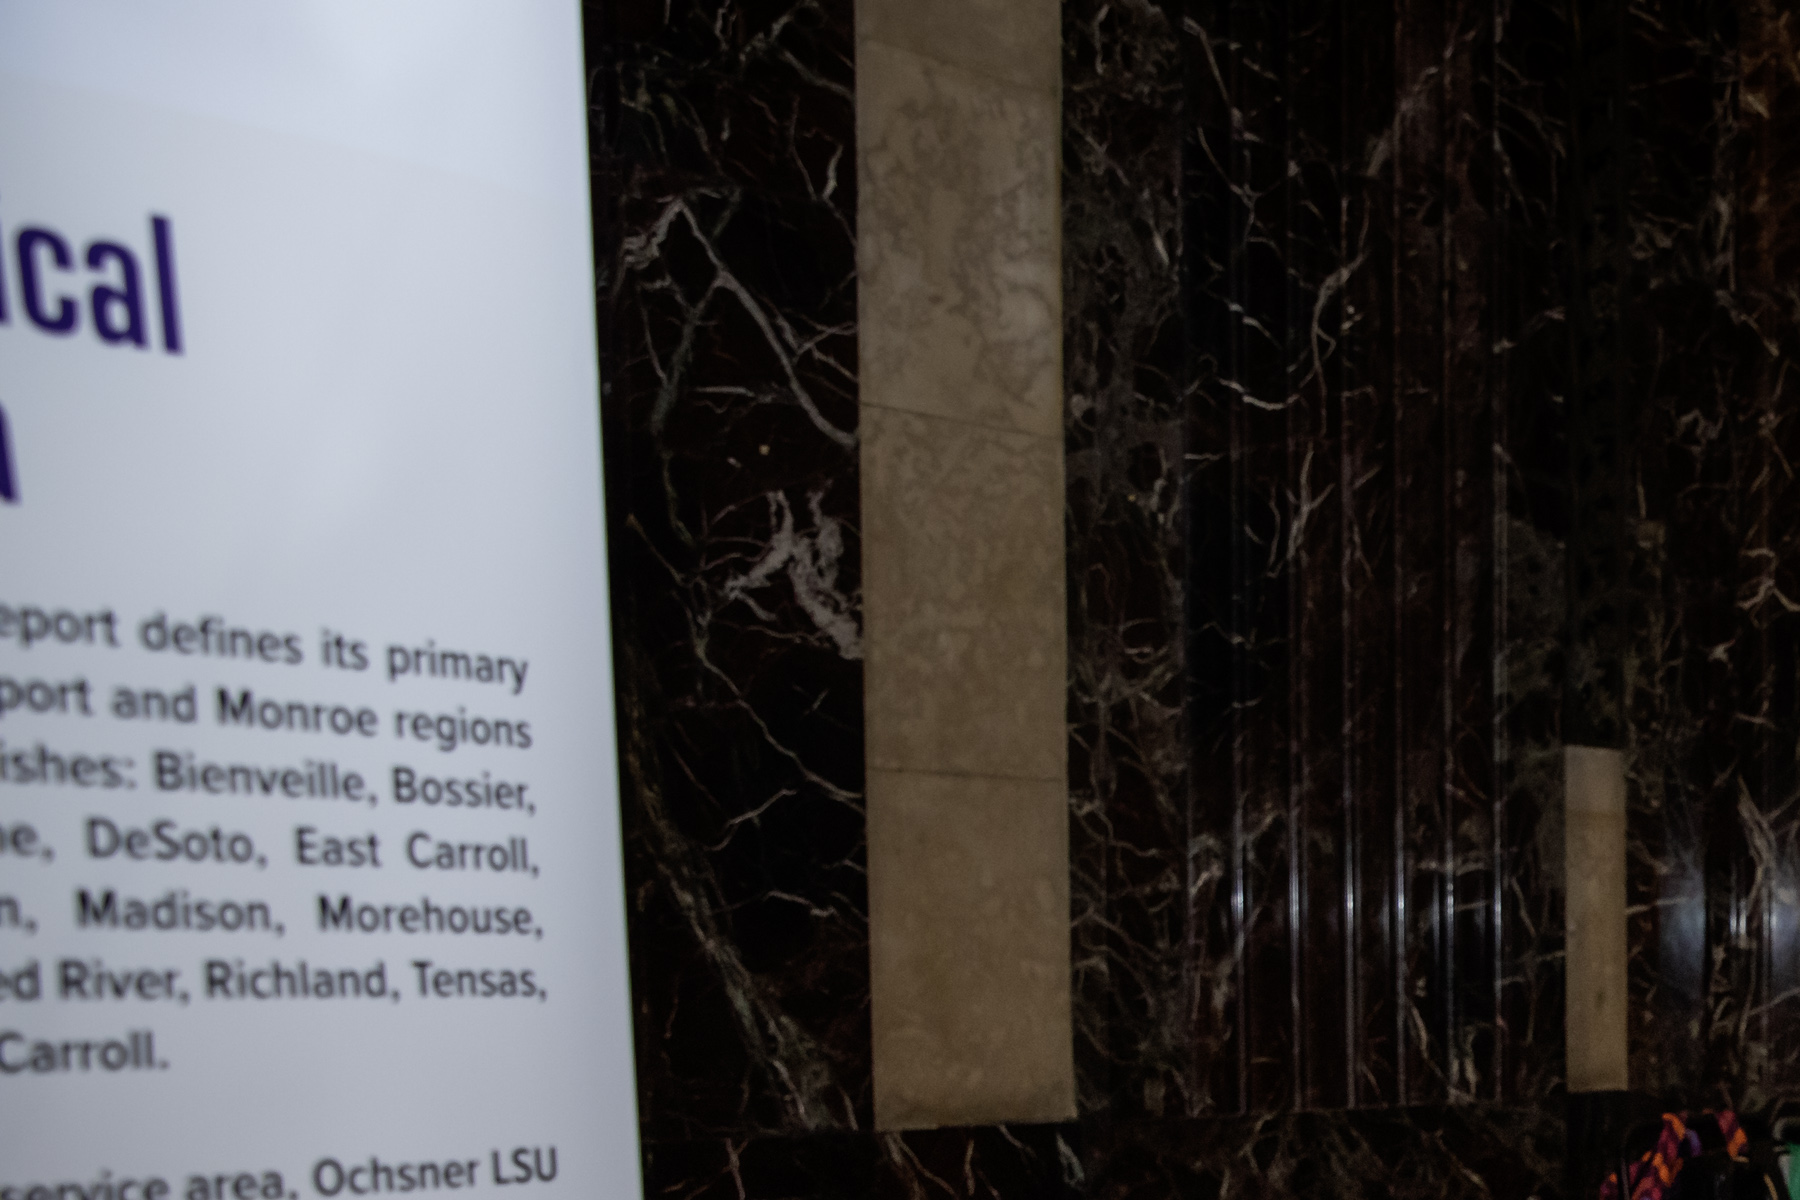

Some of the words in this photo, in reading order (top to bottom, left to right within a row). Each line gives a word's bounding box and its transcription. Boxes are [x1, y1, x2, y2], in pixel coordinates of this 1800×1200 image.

[139, 612, 303, 665] defines
[320, 627, 369, 671] its
[387, 639, 529, 696] primary
[111, 686, 198, 724] and
[215, 686, 378, 737] Monroe
[394, 707, 533, 753] regions
[152, 750, 378, 808] Bienveille,
[390, 765, 537, 815] Bossier,
[84, 817, 269, 869] DeSoto,
[295, 827, 383, 869] East
[405, 831, 541, 878] Carroll,
[75, 889, 285, 937] Madison,
[315, 894, 544, 940] Morehouse,
[57, 959, 192, 1006] River,
[204, 958, 402, 1006] Richland,
[411, 959, 548, 1004] Tensas,
[0, 1030, 170, 1075] Carroll.
[313, 1156, 480, 1198] Ochsner
[491, 1147, 559, 1185] LSU
